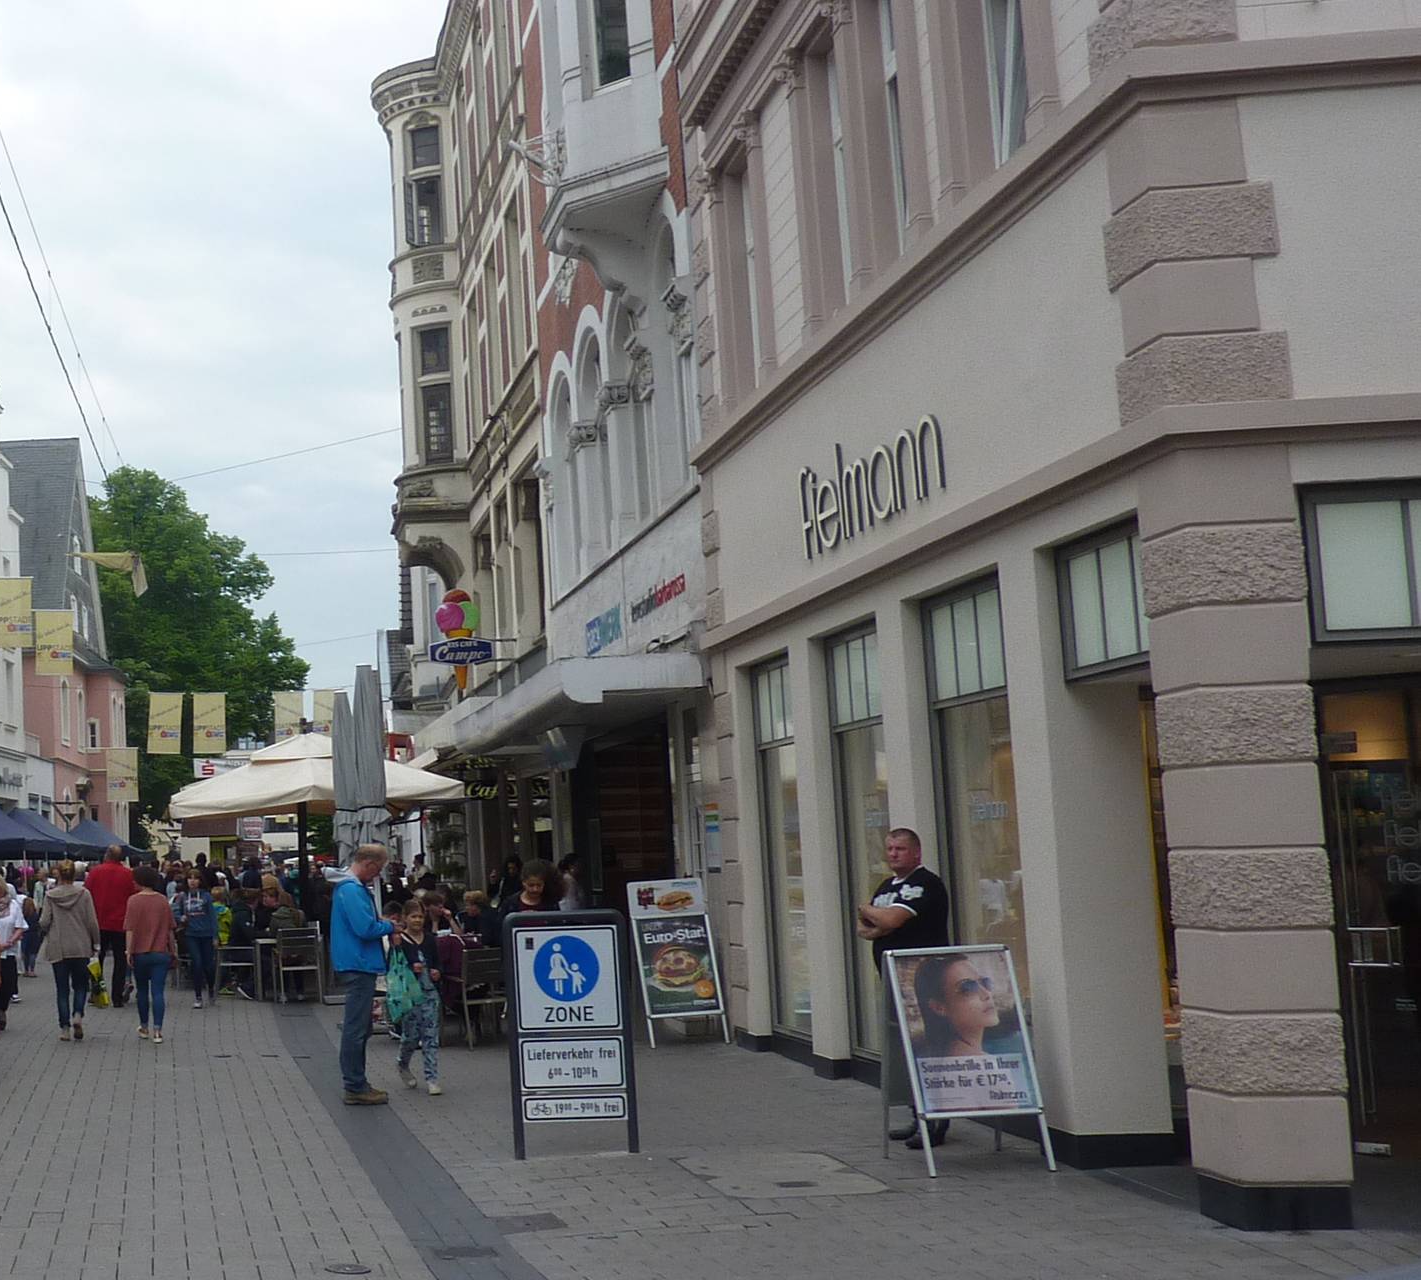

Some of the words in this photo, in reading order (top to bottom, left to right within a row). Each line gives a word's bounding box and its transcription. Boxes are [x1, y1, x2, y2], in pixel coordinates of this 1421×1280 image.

[799, 414, 946, 560] fielmann
[435, 645, 489, 663] Campo
[643, 926, 706, 945] Euro-Star!
[544, 1006, 594, 1023] ZONE
[527, 1048, 594, 1061] Lieferverkehr
[599, 1047, 616, 1059] frei
[921, 1058, 981, 1073] Sonnenbrille
[984, 1060, 994, 1070] in
[997, 1058, 1020, 1070] Ihrer
[924, 1076, 955, 1089] Stärke
[958, 1075, 973, 1087] für
[604, 1101, 619, 1112] frei
